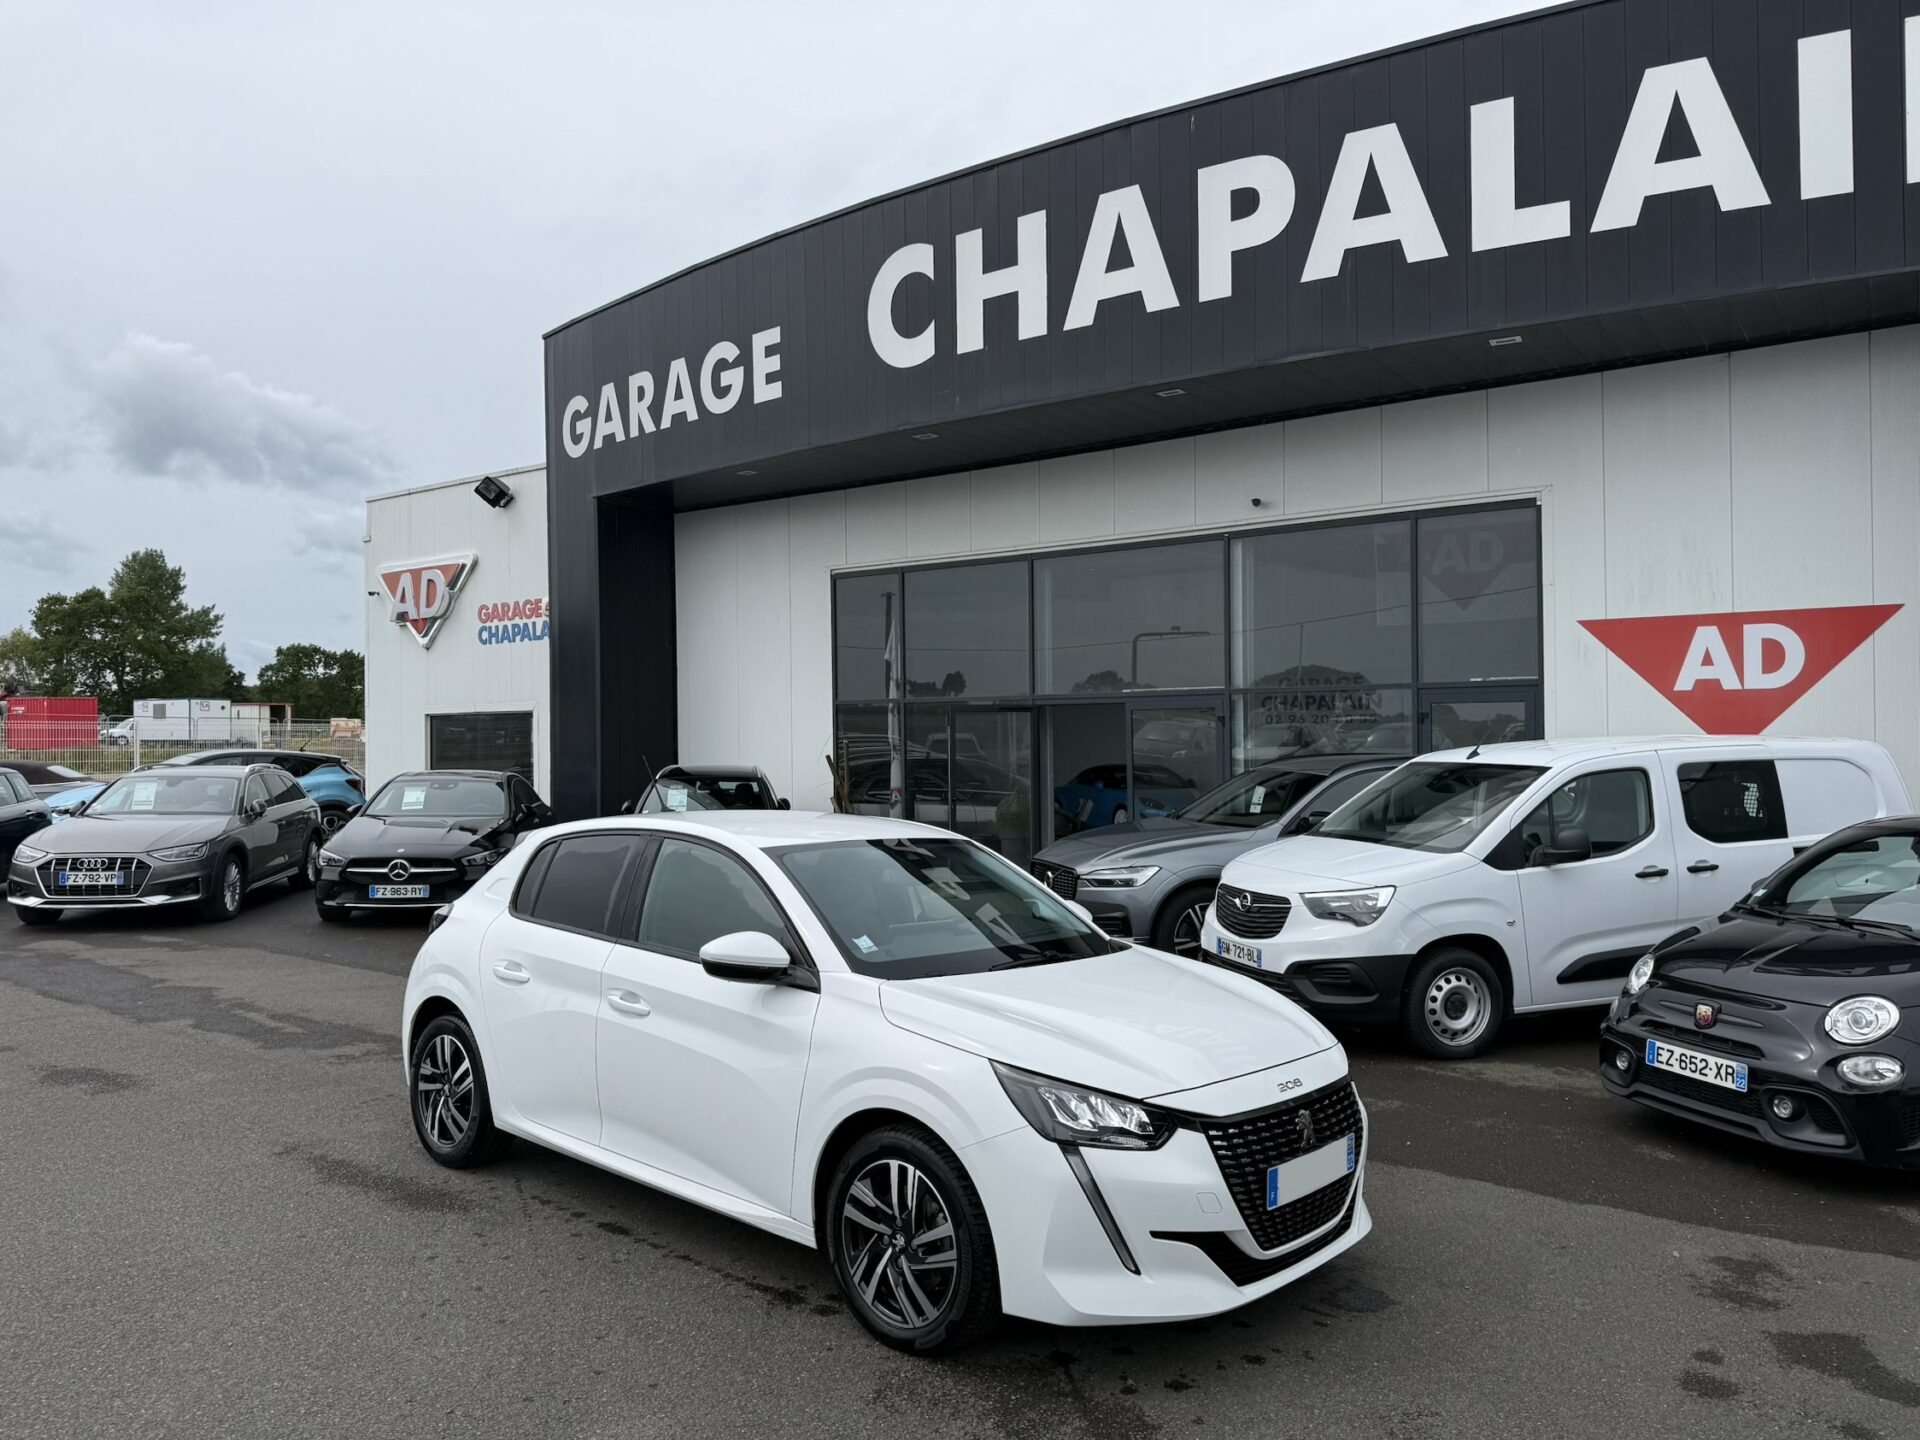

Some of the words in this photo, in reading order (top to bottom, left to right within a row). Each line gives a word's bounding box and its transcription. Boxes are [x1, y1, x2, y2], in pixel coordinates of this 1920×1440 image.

[562, 326, 783, 459] GARAGE
[867, 15, 1920, 369] CHAPALAI
[389, 569, 447, 622] AD
[477, 598, 543, 624] GARAGE
[1673, 623, 1806, 691] AD
[66, 873, 117, 884] FZ-792-VP
[1656, 1046, 1735, 1084] EZ-652-XR
[1277, 1078, 1303, 1093] 208
